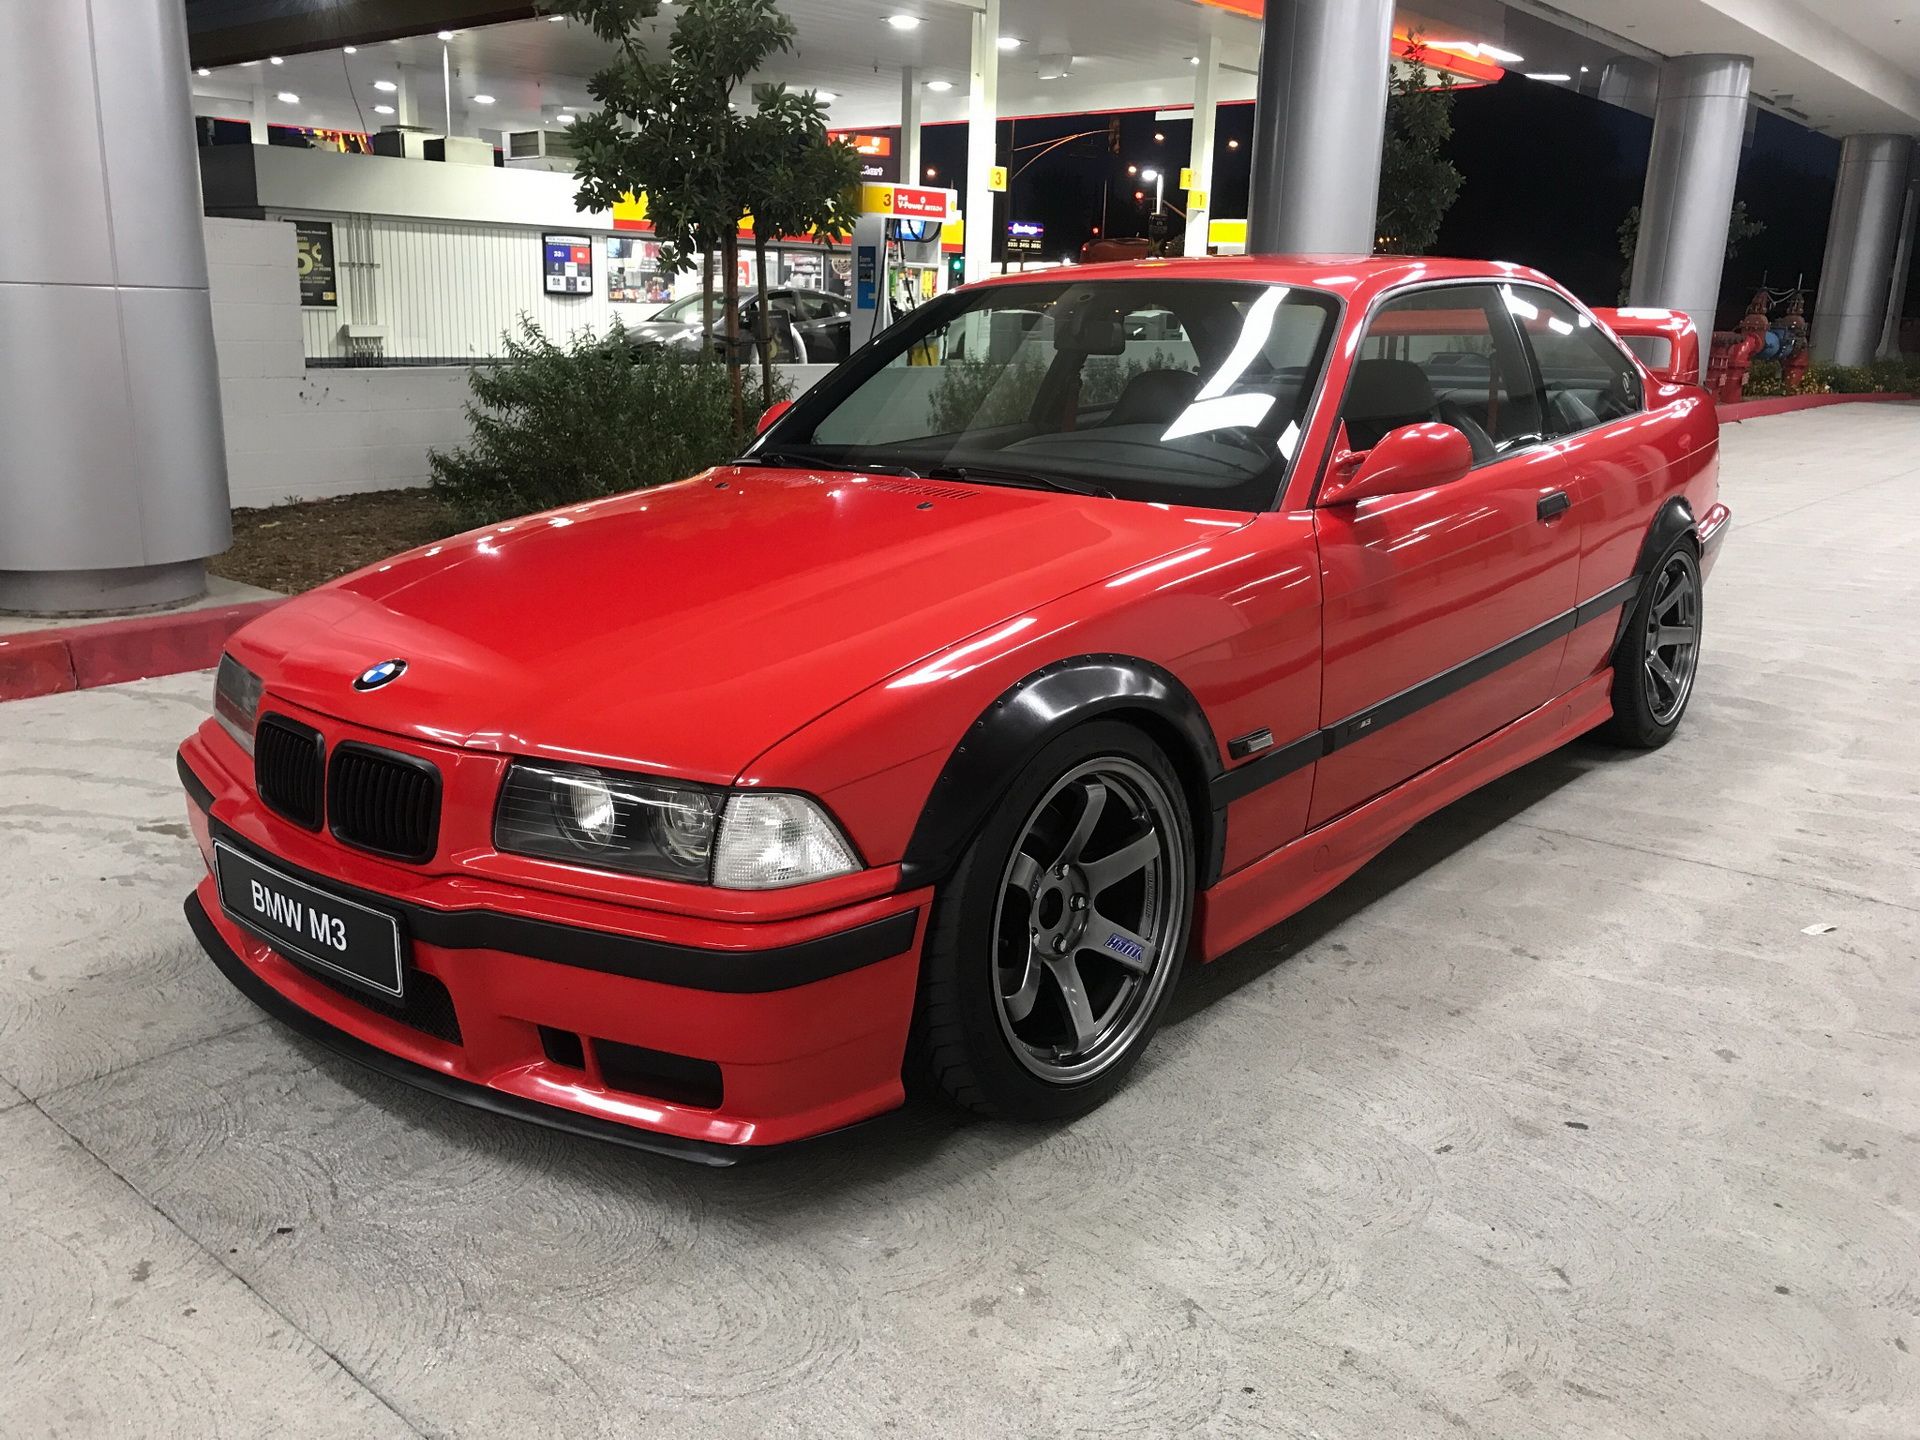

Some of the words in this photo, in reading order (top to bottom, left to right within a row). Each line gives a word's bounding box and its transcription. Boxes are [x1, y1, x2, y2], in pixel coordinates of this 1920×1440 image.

[994, 171, 1002, 186] 3
[883, 193, 892, 207] 3
[251, 879, 301, 933] BMW
[308, 907, 348, 952] M3
